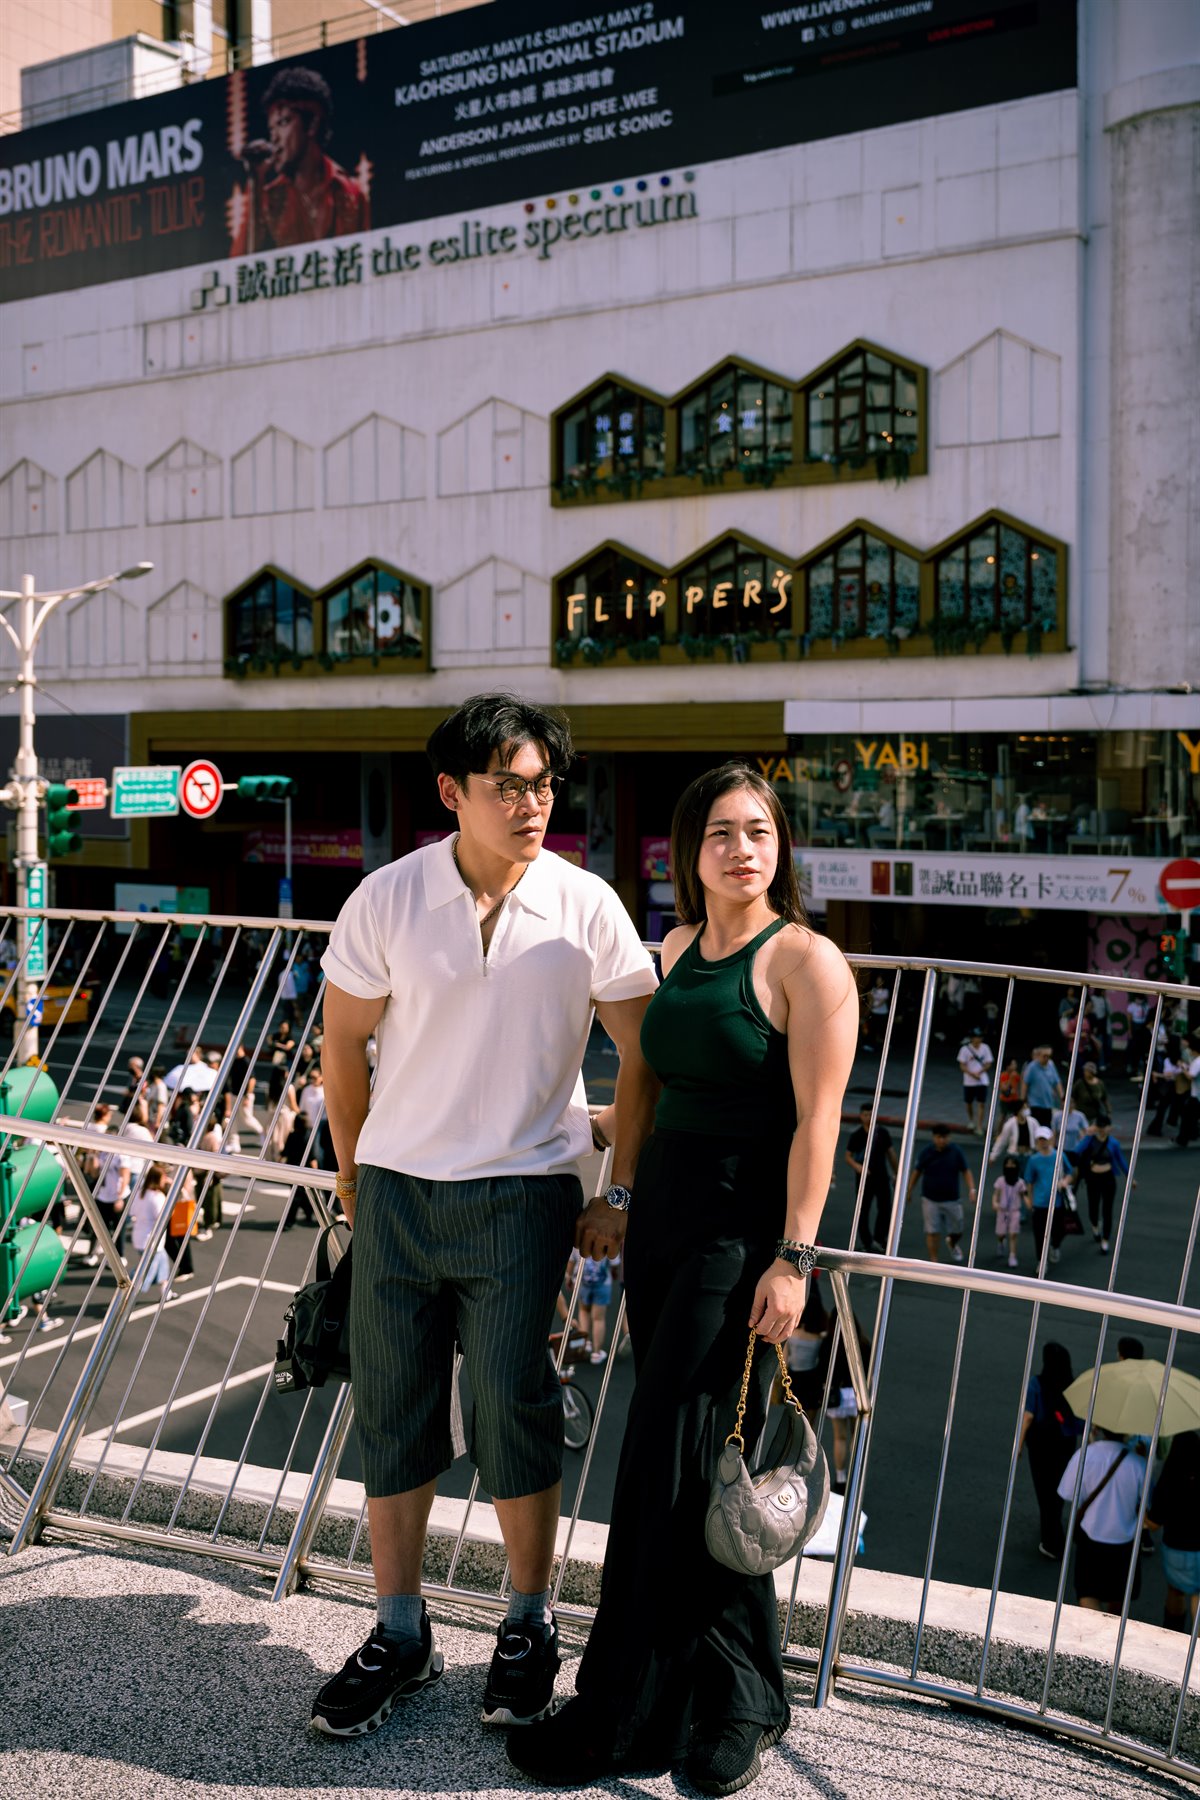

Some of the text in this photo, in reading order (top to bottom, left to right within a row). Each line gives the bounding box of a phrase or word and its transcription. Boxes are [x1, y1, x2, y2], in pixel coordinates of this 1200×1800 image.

[394, 15, 685, 107] KAOHSIUNG NATIONAL STADIUM
[420, 45, 493, 77] SATURDAY,
[493, 36, 525, 58] MAY
[532, 31, 544, 48] &
[544, 15, 607, 44] SUNDAY,
[607, 5, 642, 28] MAY
[643, 2, 654, 19] 2
[419, 124, 498, 157] ANDERSON
[544, 108, 567, 128] AS
[567, 103, 589, 124] DJ
[590, 96, 618, 119] PEE
[462, 151, 498, 169] SPECIAL
[498, 137, 566, 161] PERFORMANCE
[567, 132, 582, 146] BY
[583, 121, 617, 144] SILK
[618, 109, 673, 136] SONIC
[0, 118, 204, 216] BRUNO MARS
[39, 192, 142, 260] ROMANTIC
[147, 176, 205, 236] TOUR
[371, 190, 698, 277] the eslite spectrum
[236, 241, 363, 303] 誠品生活
[566, 574, 792, 631] FLIPPER'S
[757, 757, 818, 783] YABI
[855, 741, 929, 771] YABI
[931, 868, 1054, 899] 誠品聯名卡
